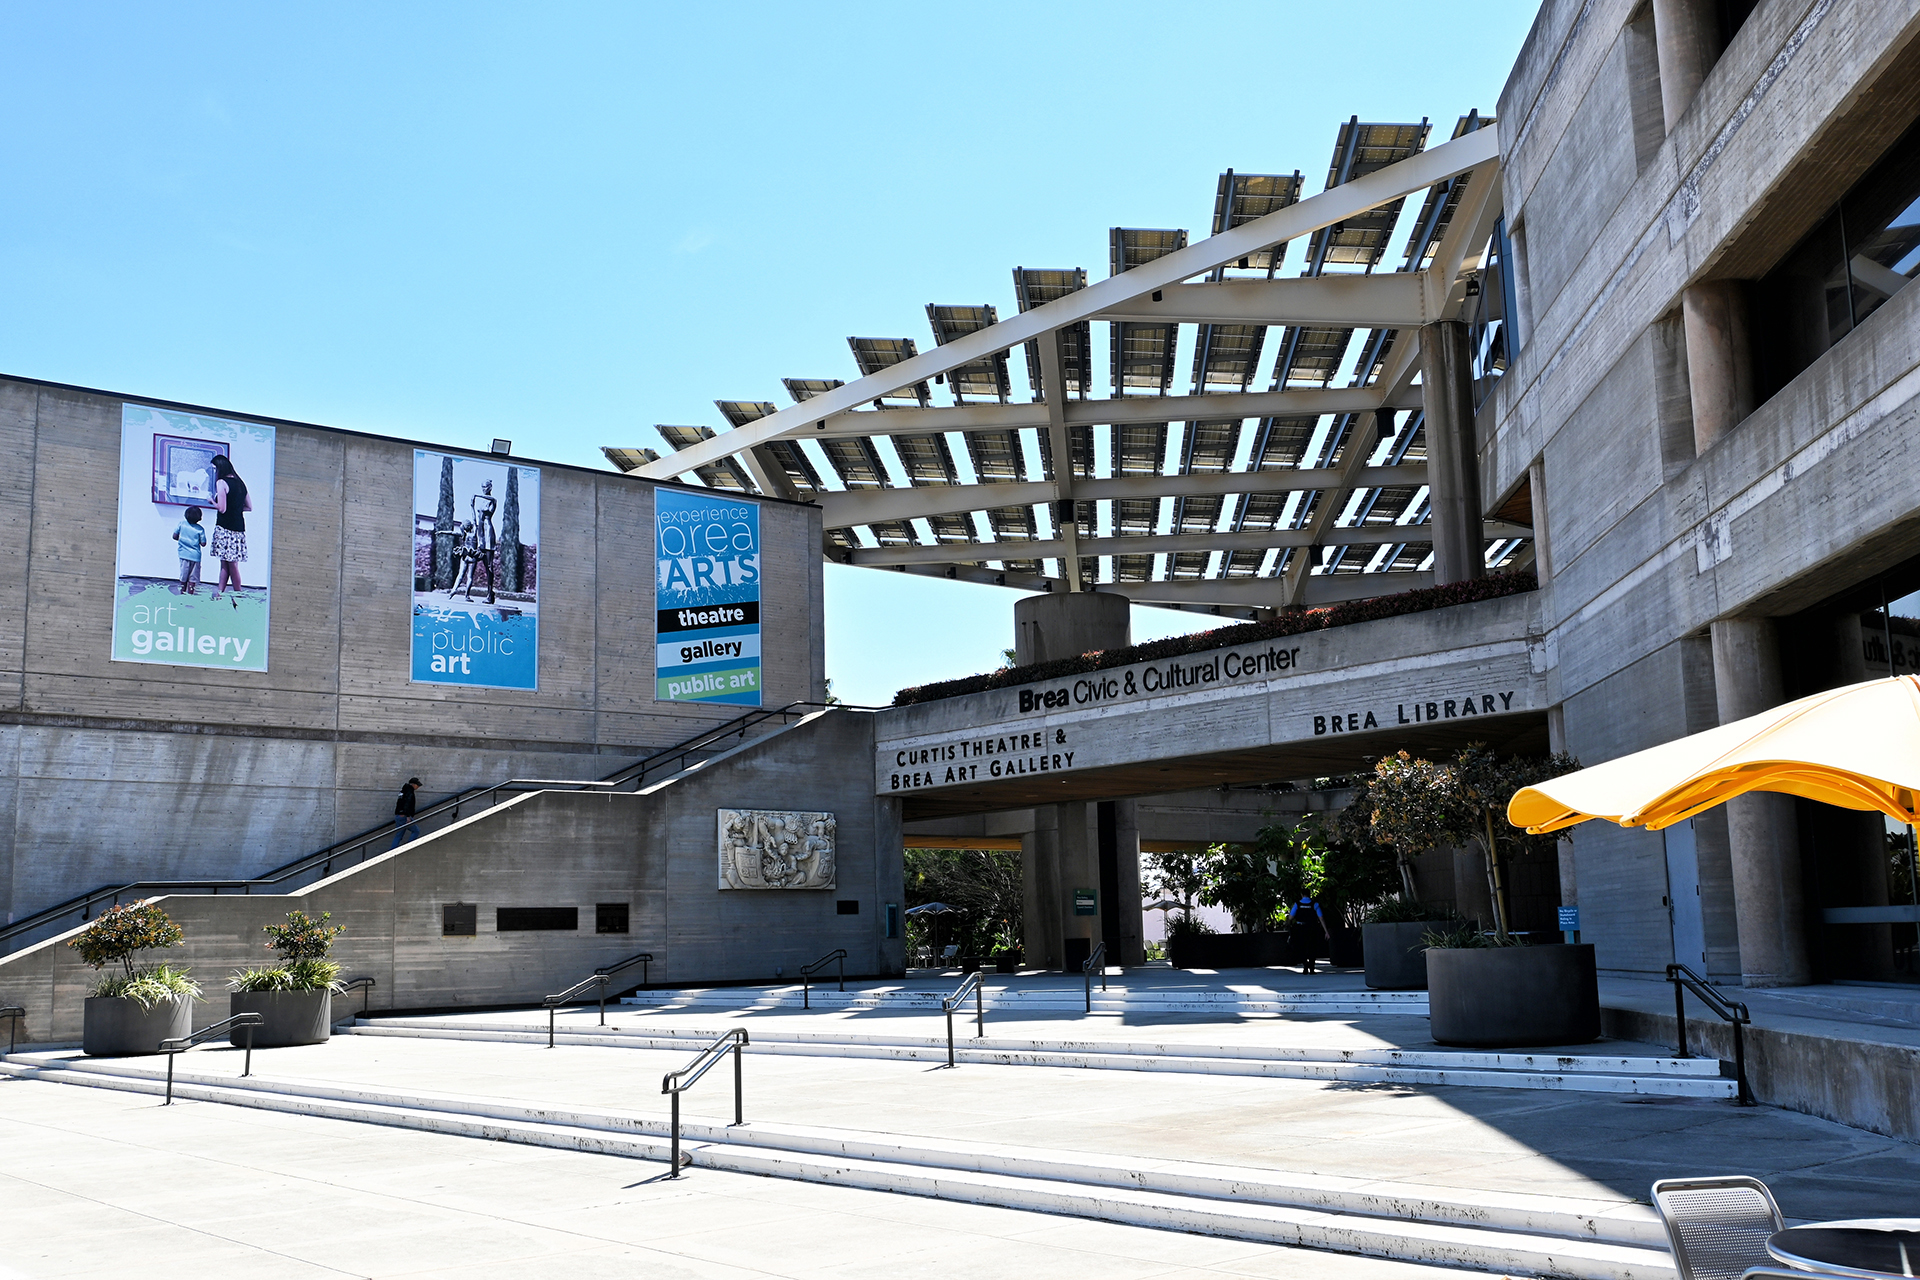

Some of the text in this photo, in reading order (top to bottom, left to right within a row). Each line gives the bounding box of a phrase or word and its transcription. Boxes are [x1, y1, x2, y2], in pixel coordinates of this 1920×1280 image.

[660, 506, 749, 525] experience
[657, 515, 754, 556] brea
[665, 553, 759, 590] ARTS
[132, 602, 177, 627] art
[678, 607, 744, 627] theatre
[131, 626, 251, 662] gallery
[432, 628, 514, 656] public
[680, 640, 742, 663] gallery
[430, 652, 471, 675] art
[1018, 646, 1300, 713] Brea Civic & Cultural Center
[668, 670, 756, 699] public art
[1313, 691, 1514, 735] BREA LIBRARY
[896, 728, 1067, 767] CURTIS THEATRE &
[891, 751, 1075, 790] BREA ART GALLERY
